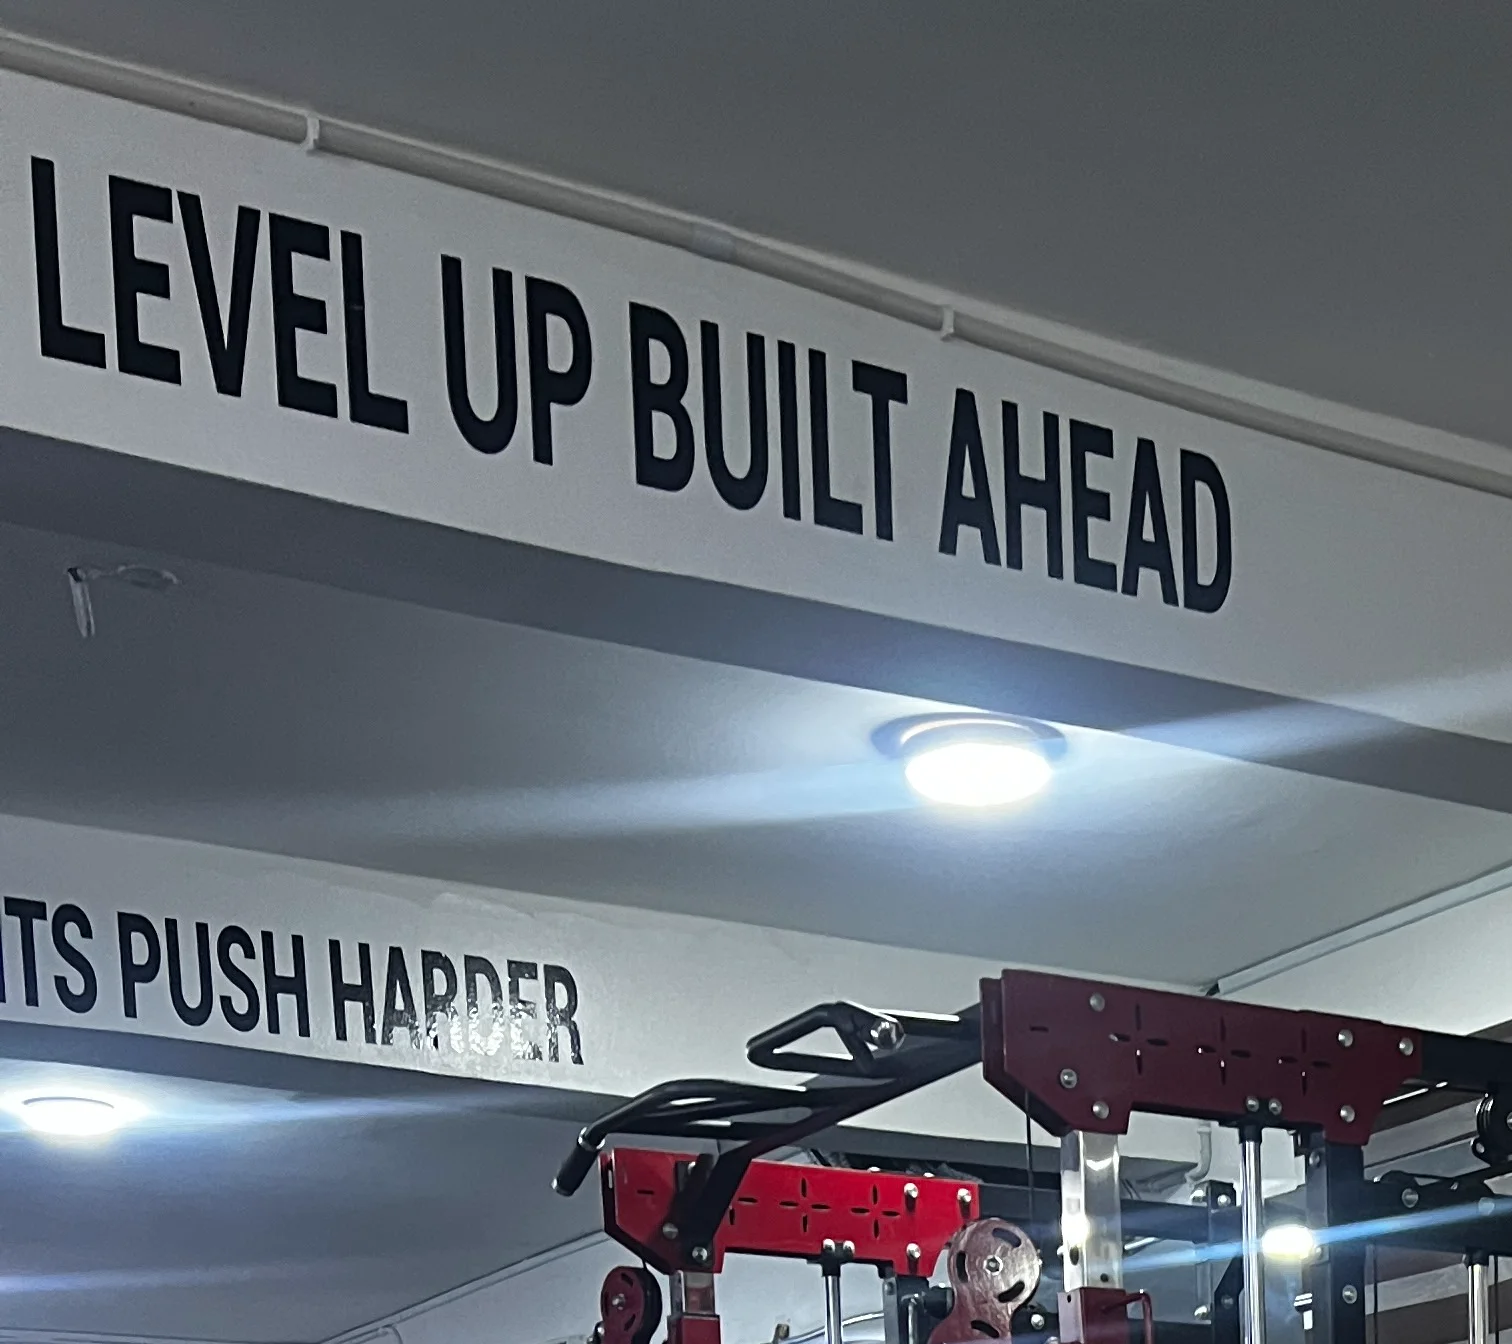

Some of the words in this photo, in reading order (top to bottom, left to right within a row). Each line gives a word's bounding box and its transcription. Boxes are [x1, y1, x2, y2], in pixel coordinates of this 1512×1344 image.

[31, 155, 409, 434] LEVEL
[440, 253, 592, 466] UP
[629, 301, 908, 541] BUILT
[938, 387, 1232, 613] AHEAD
[117, 911, 311, 1038] PUSH
[328, 939, 585, 1065] HARDER
